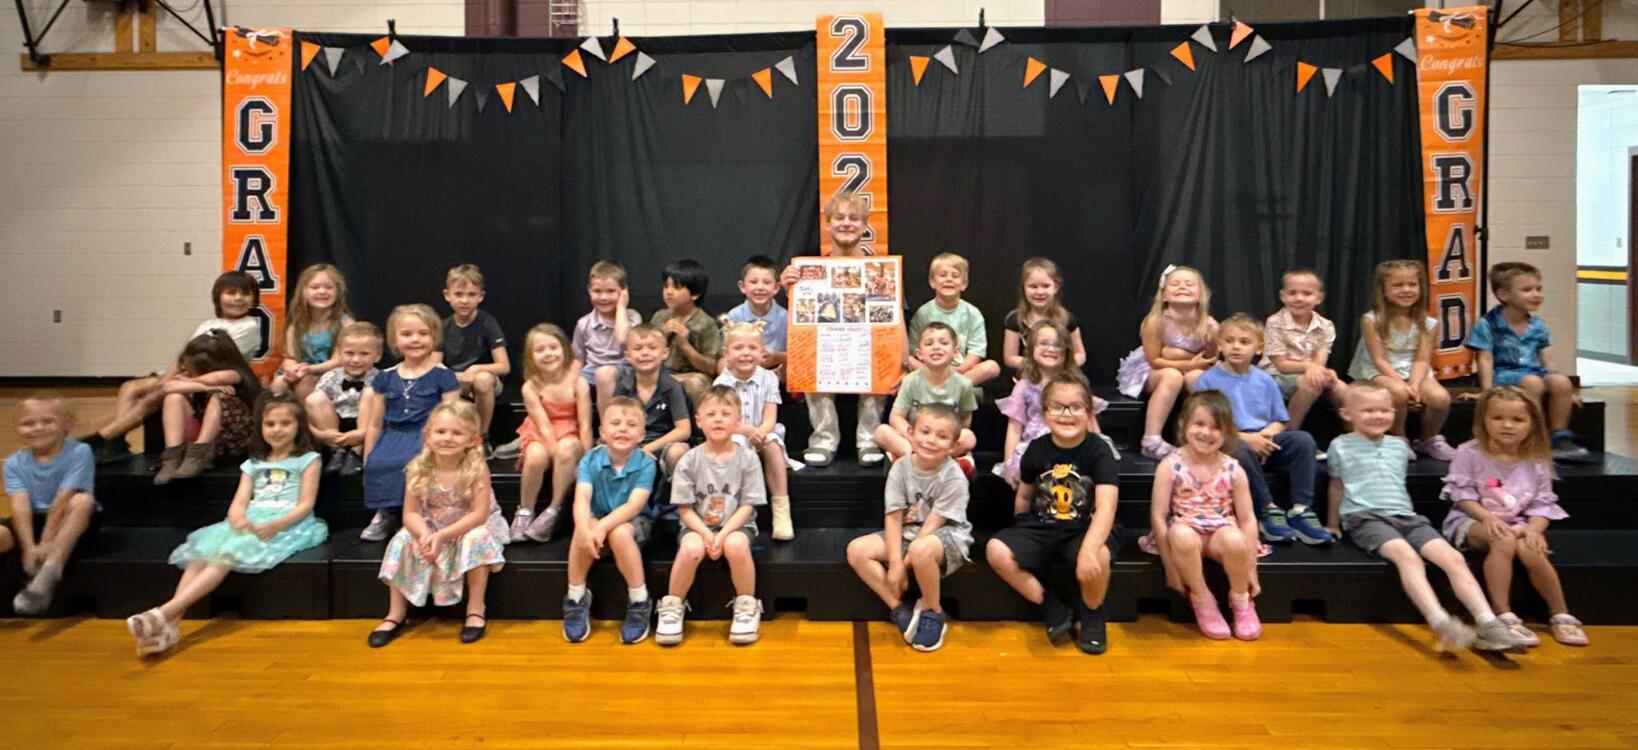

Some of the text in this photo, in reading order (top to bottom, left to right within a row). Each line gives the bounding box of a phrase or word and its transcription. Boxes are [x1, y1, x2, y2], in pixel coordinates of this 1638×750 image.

[225, 68, 288, 90] Congrats
[1420, 54, 1484, 76] Congrats
[830, 15, 874, 256] 202
[1431, 80, 1477, 355] GRAD
